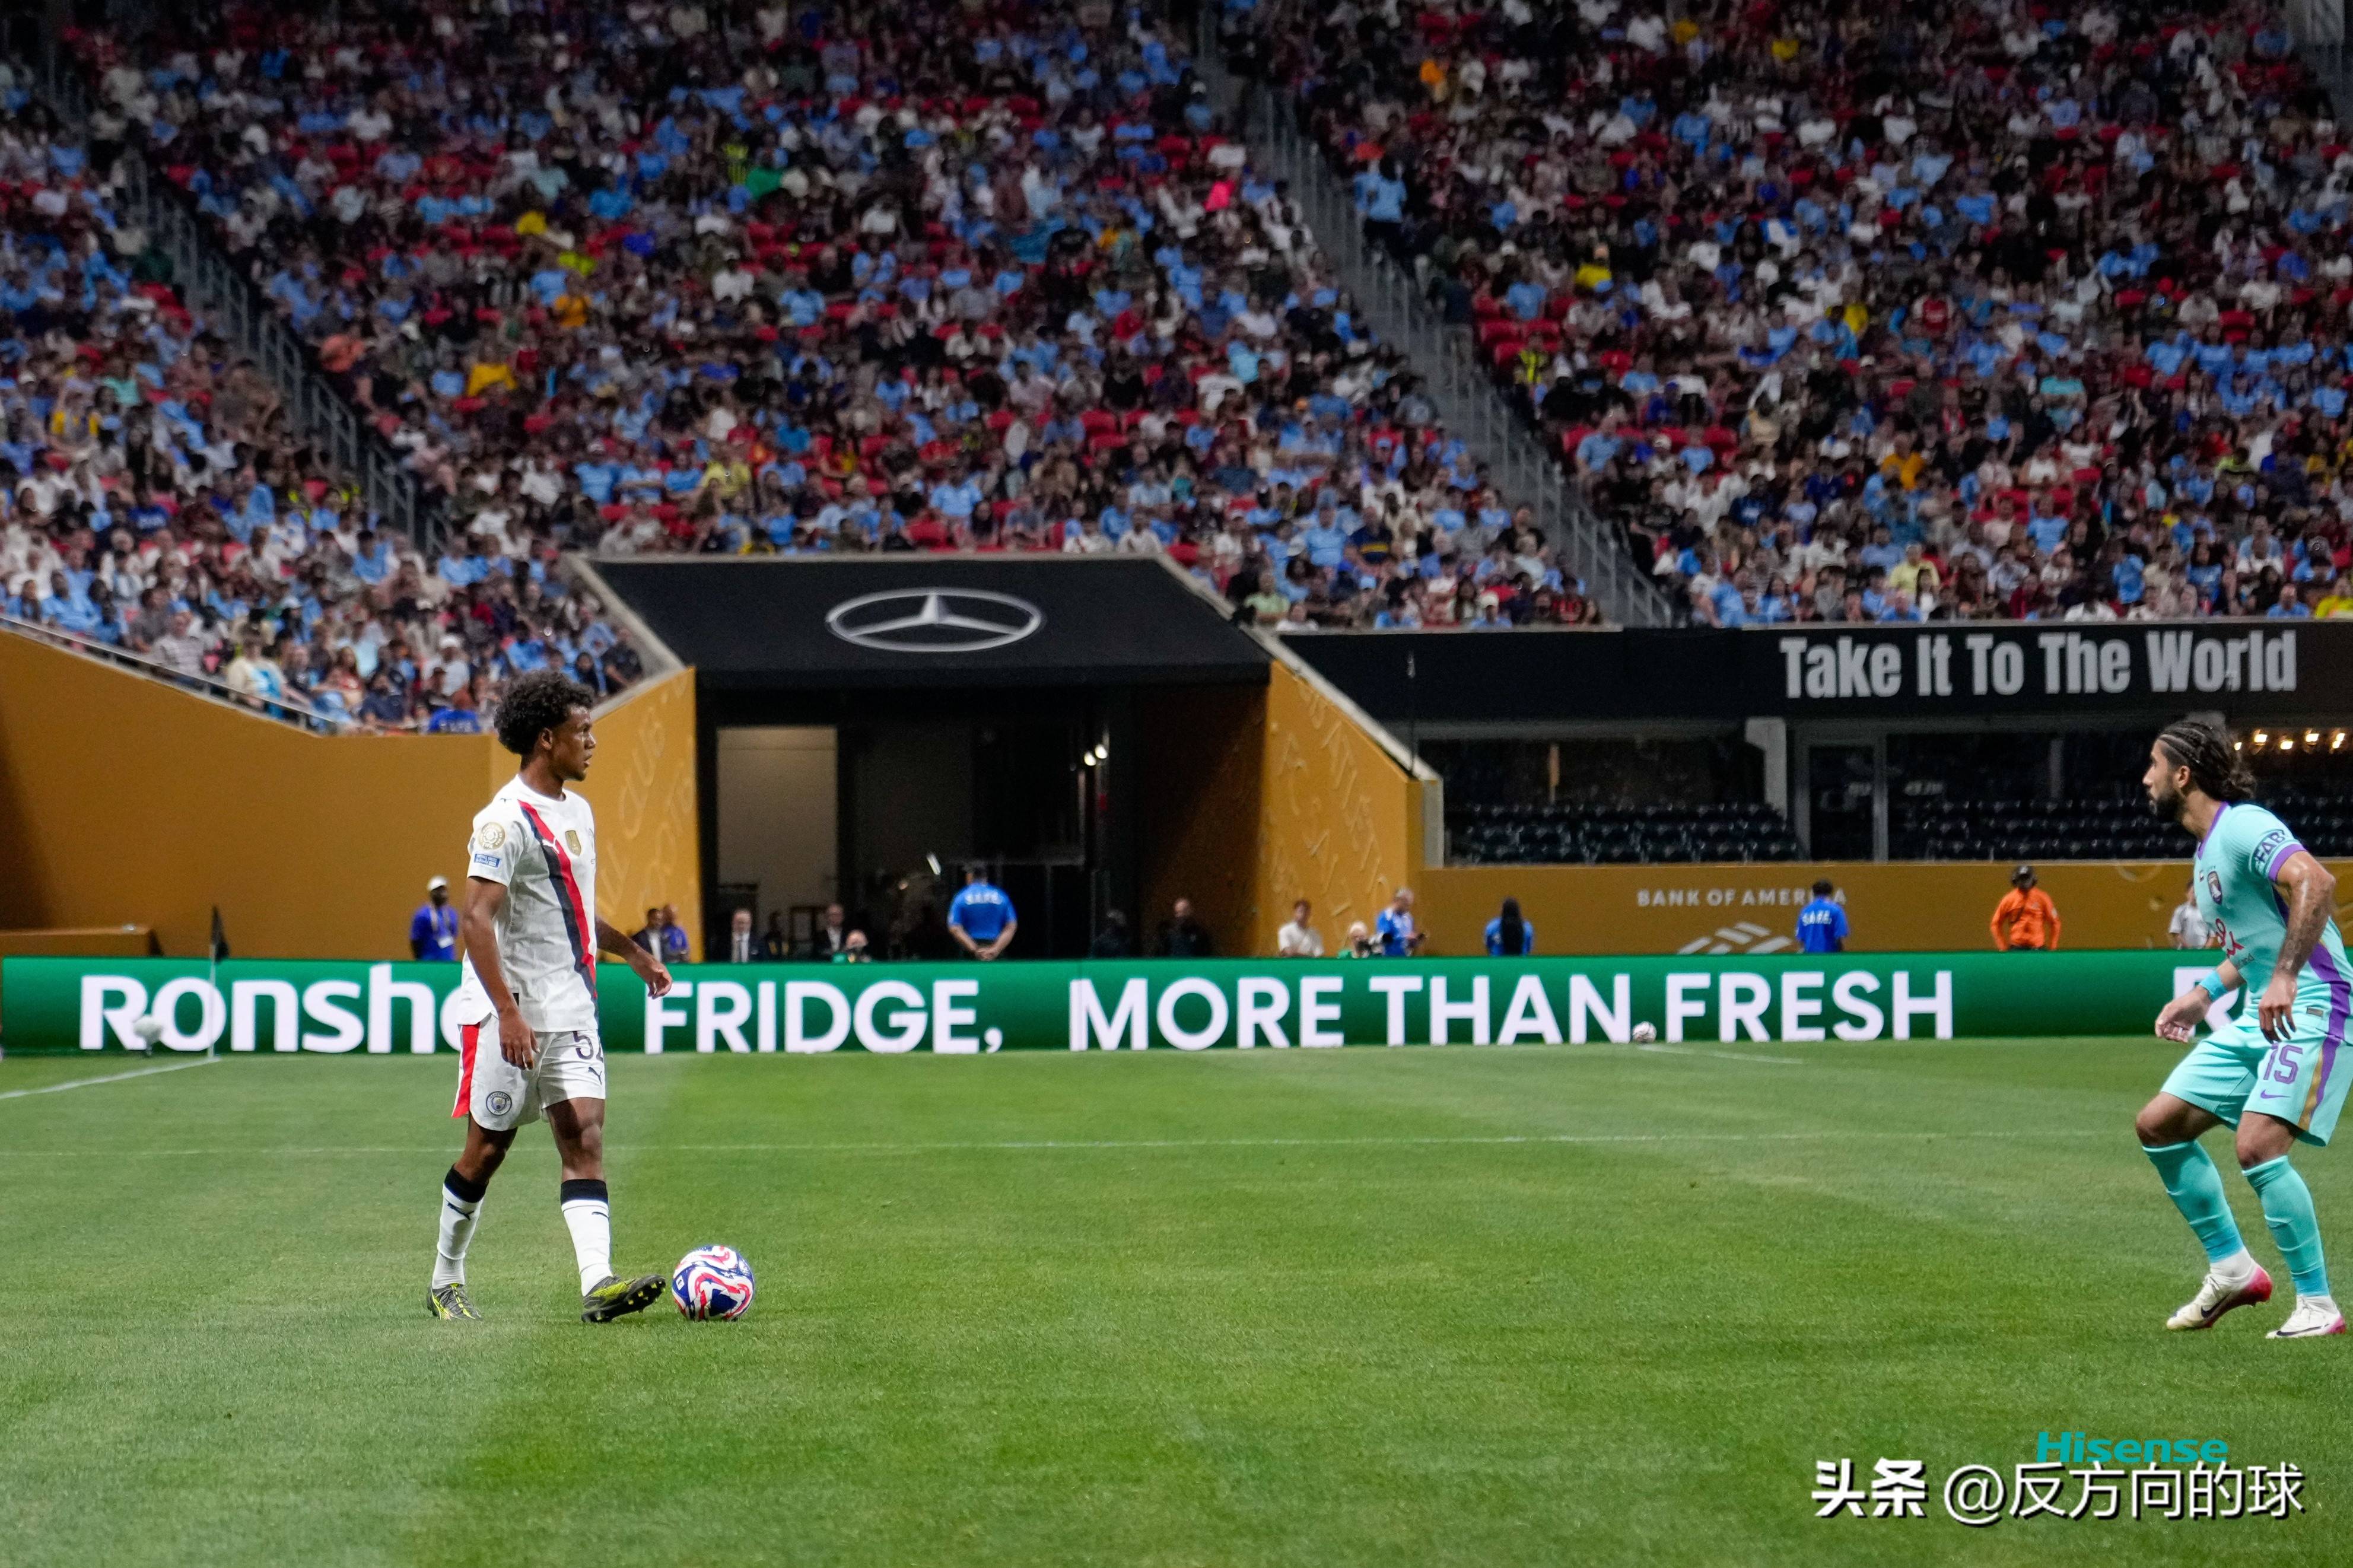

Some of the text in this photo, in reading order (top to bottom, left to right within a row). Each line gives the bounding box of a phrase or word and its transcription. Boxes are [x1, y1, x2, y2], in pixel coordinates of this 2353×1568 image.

[1779, 629, 2298, 699] Take It To The World
[1636, 889, 1700, 907] BANK
[1706, 888, 1736, 907] OF
[645, 979, 1003, 1055] FRIDGE,
[1069, 975, 1344, 1051] MORE
[1369, 974, 1630, 1047] THAN
[1665, 970, 1953, 1043] FRESH
[2263, 1042, 2303, 1085] 15
